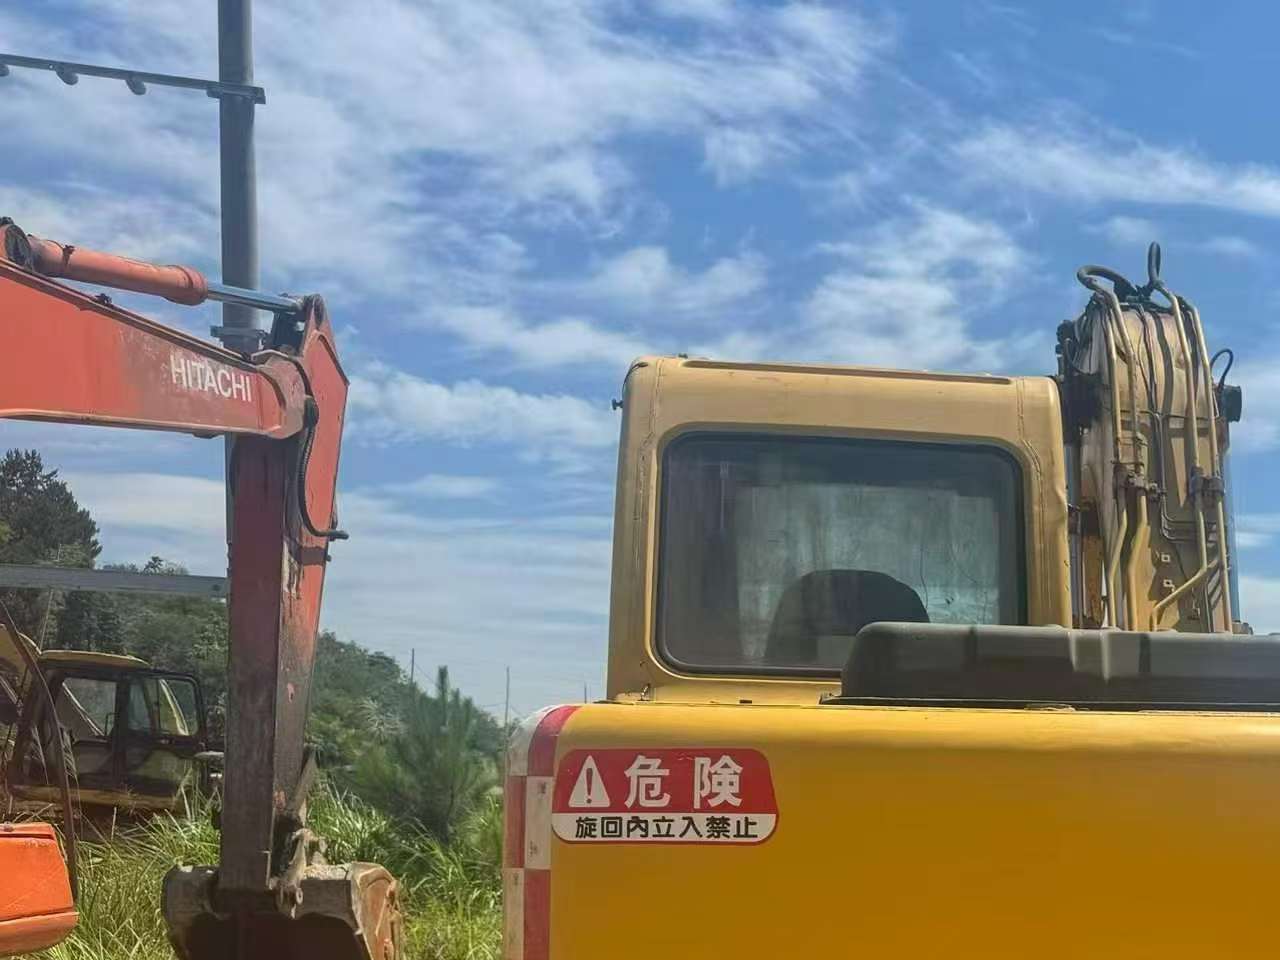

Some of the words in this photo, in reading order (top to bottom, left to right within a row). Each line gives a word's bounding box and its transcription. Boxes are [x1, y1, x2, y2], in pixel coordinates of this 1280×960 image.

[170, 355, 252, 402] HITACHI
[624, 755, 744, 809] 危険
[575, 815, 759, 839] 旋回内立入禁止
